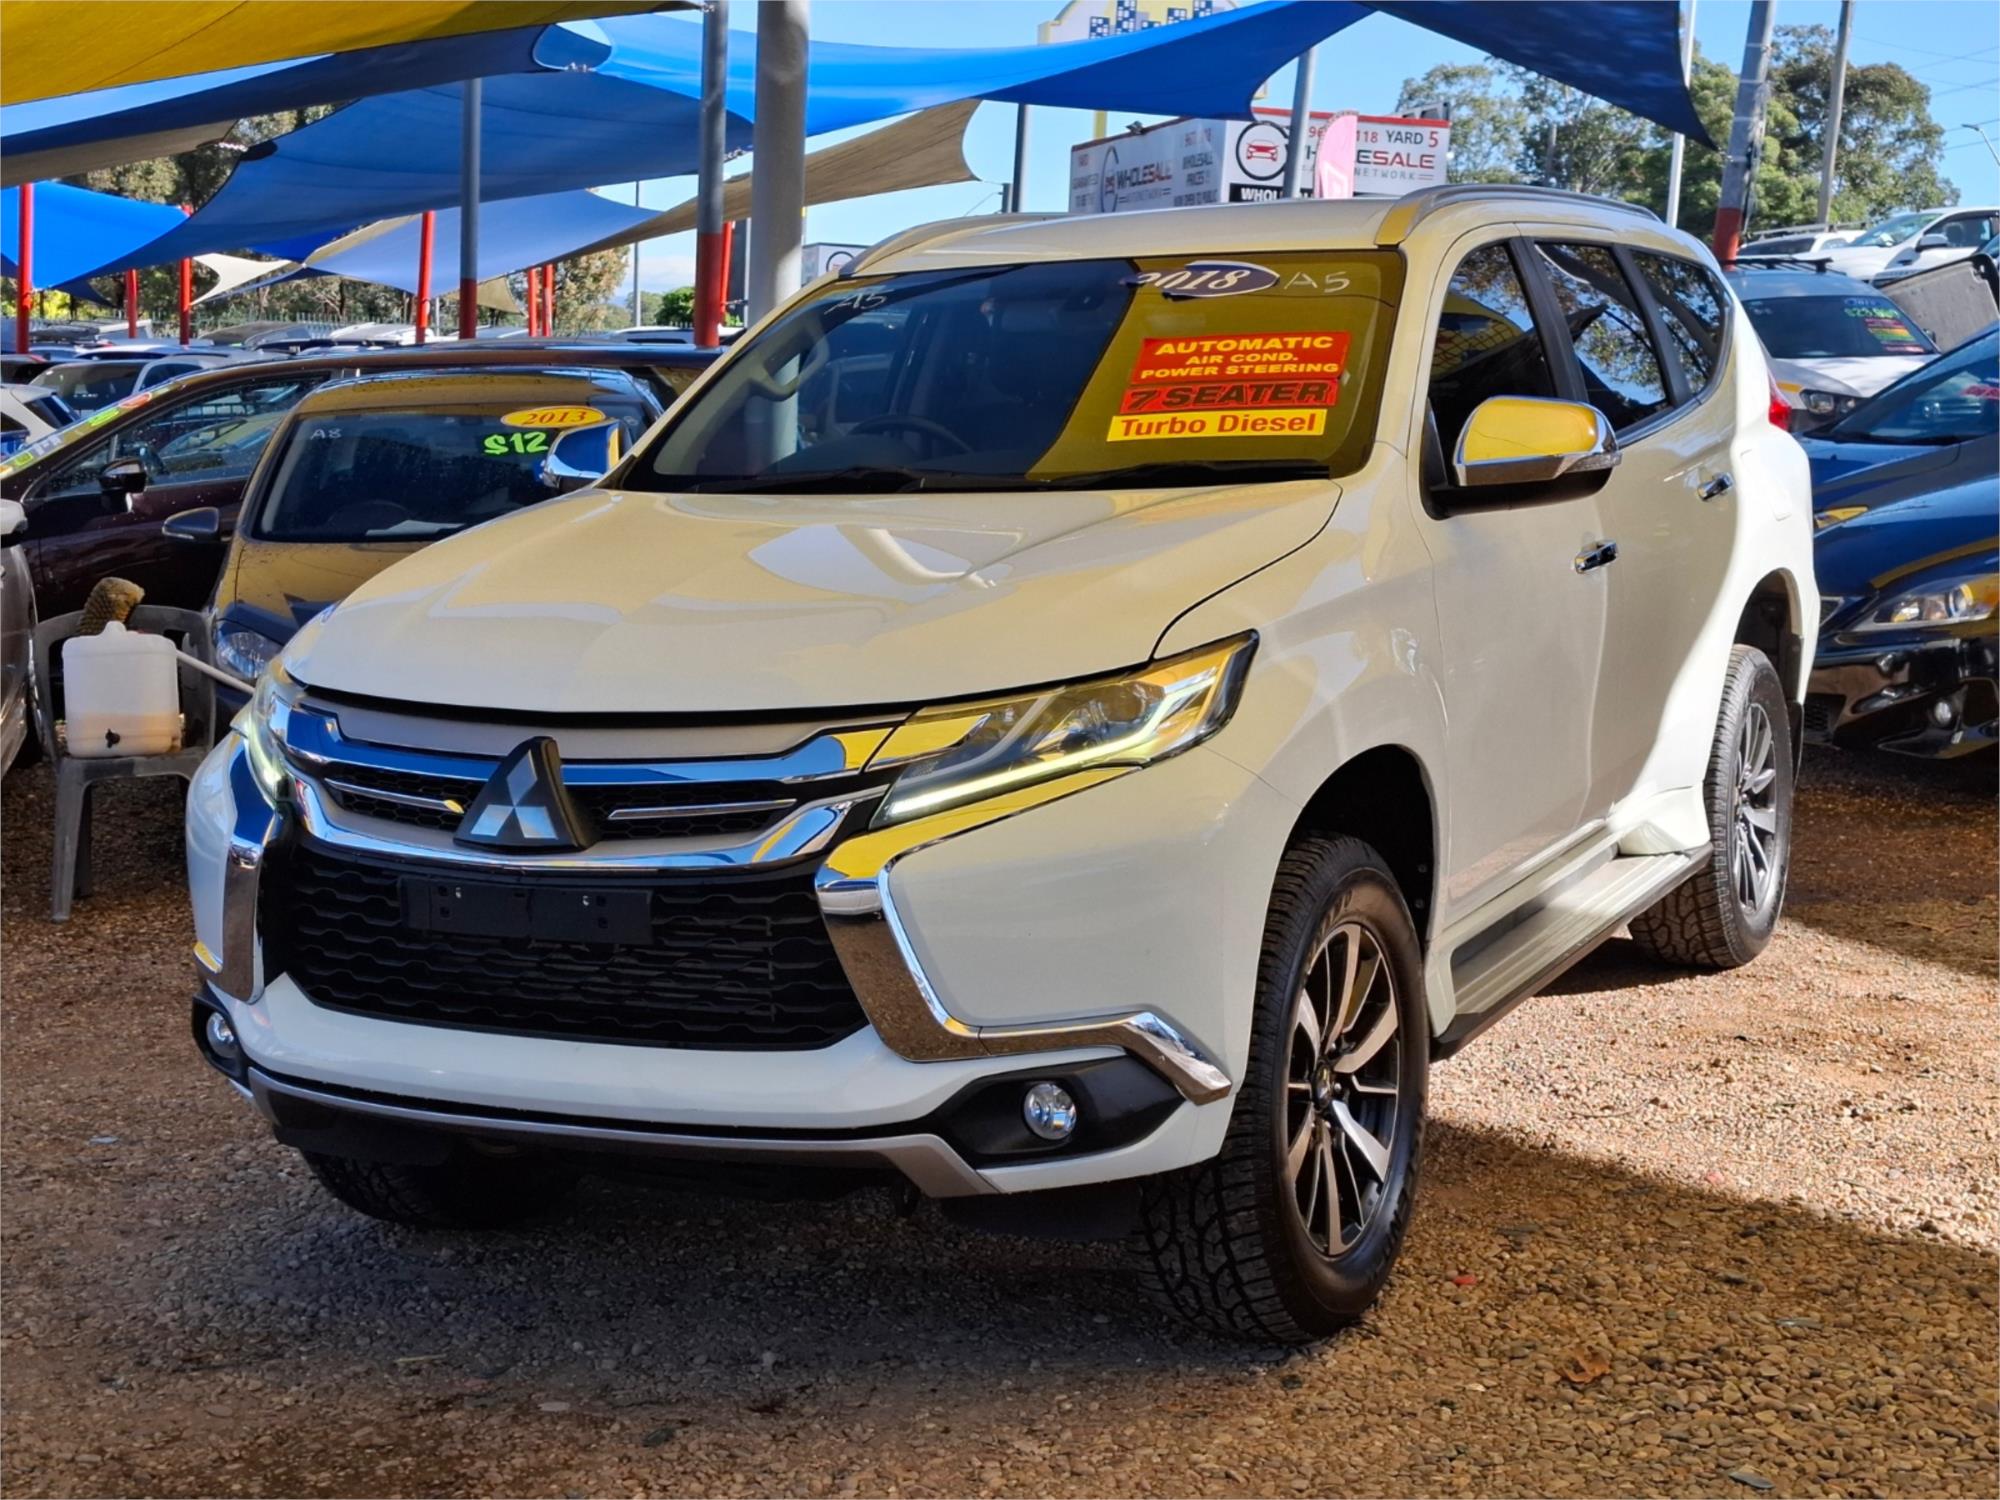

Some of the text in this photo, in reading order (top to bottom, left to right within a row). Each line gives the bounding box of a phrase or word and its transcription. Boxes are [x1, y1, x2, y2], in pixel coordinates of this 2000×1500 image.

[1386, 130, 1424, 145] YARD
[1428, 131, 1439, 148] 5
[1283, 270, 1350, 293] A5
[1155, 336, 1334, 356] AUTOMATIC
[1185, 352, 1299, 366] AIR COND.
[1140, 363, 1339, 379] POWER STEERING
[1127, 381, 1331, 412] 7 SEATER
[522, 411, 588, 426] 2013
[1121, 413, 1316, 437] Turbo Diesel
